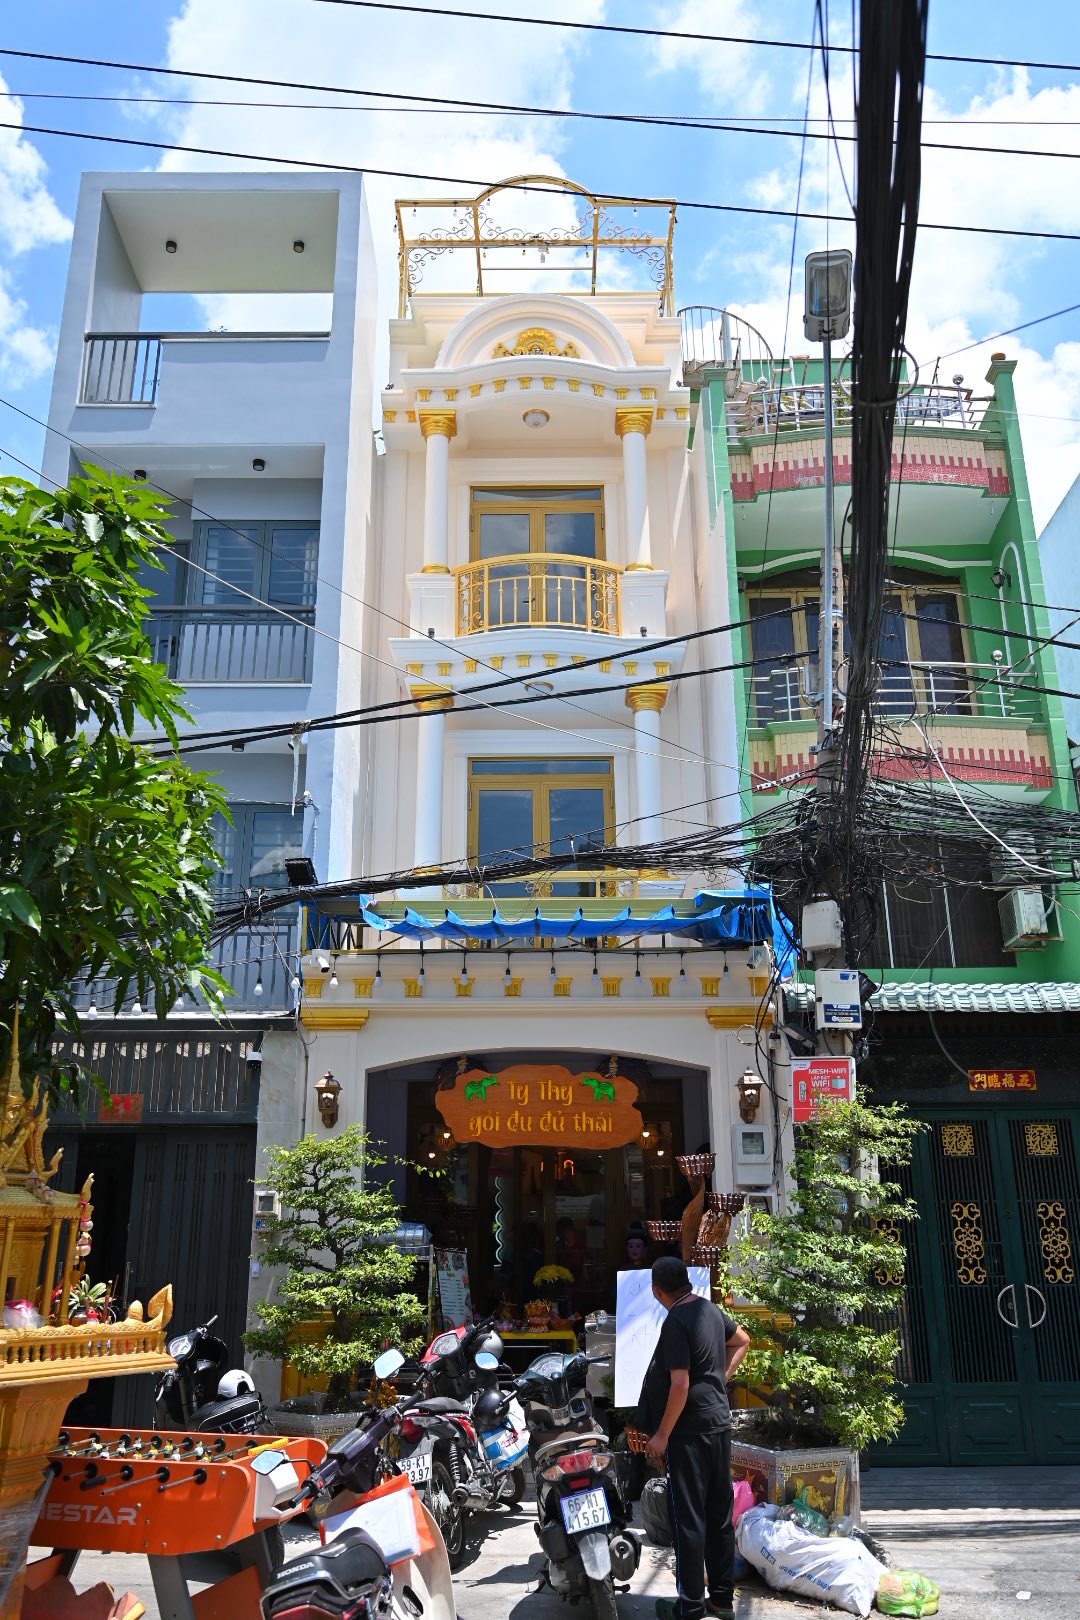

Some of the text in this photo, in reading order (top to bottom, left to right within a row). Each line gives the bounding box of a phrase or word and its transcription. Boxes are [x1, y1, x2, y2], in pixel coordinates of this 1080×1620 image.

[537, 1079, 573, 1106] Thy
[572, 1111, 613, 1133] thái
[567, 1493, 599, 1513] 66-N1
[276, 1561, 316, 1579] HONDA
